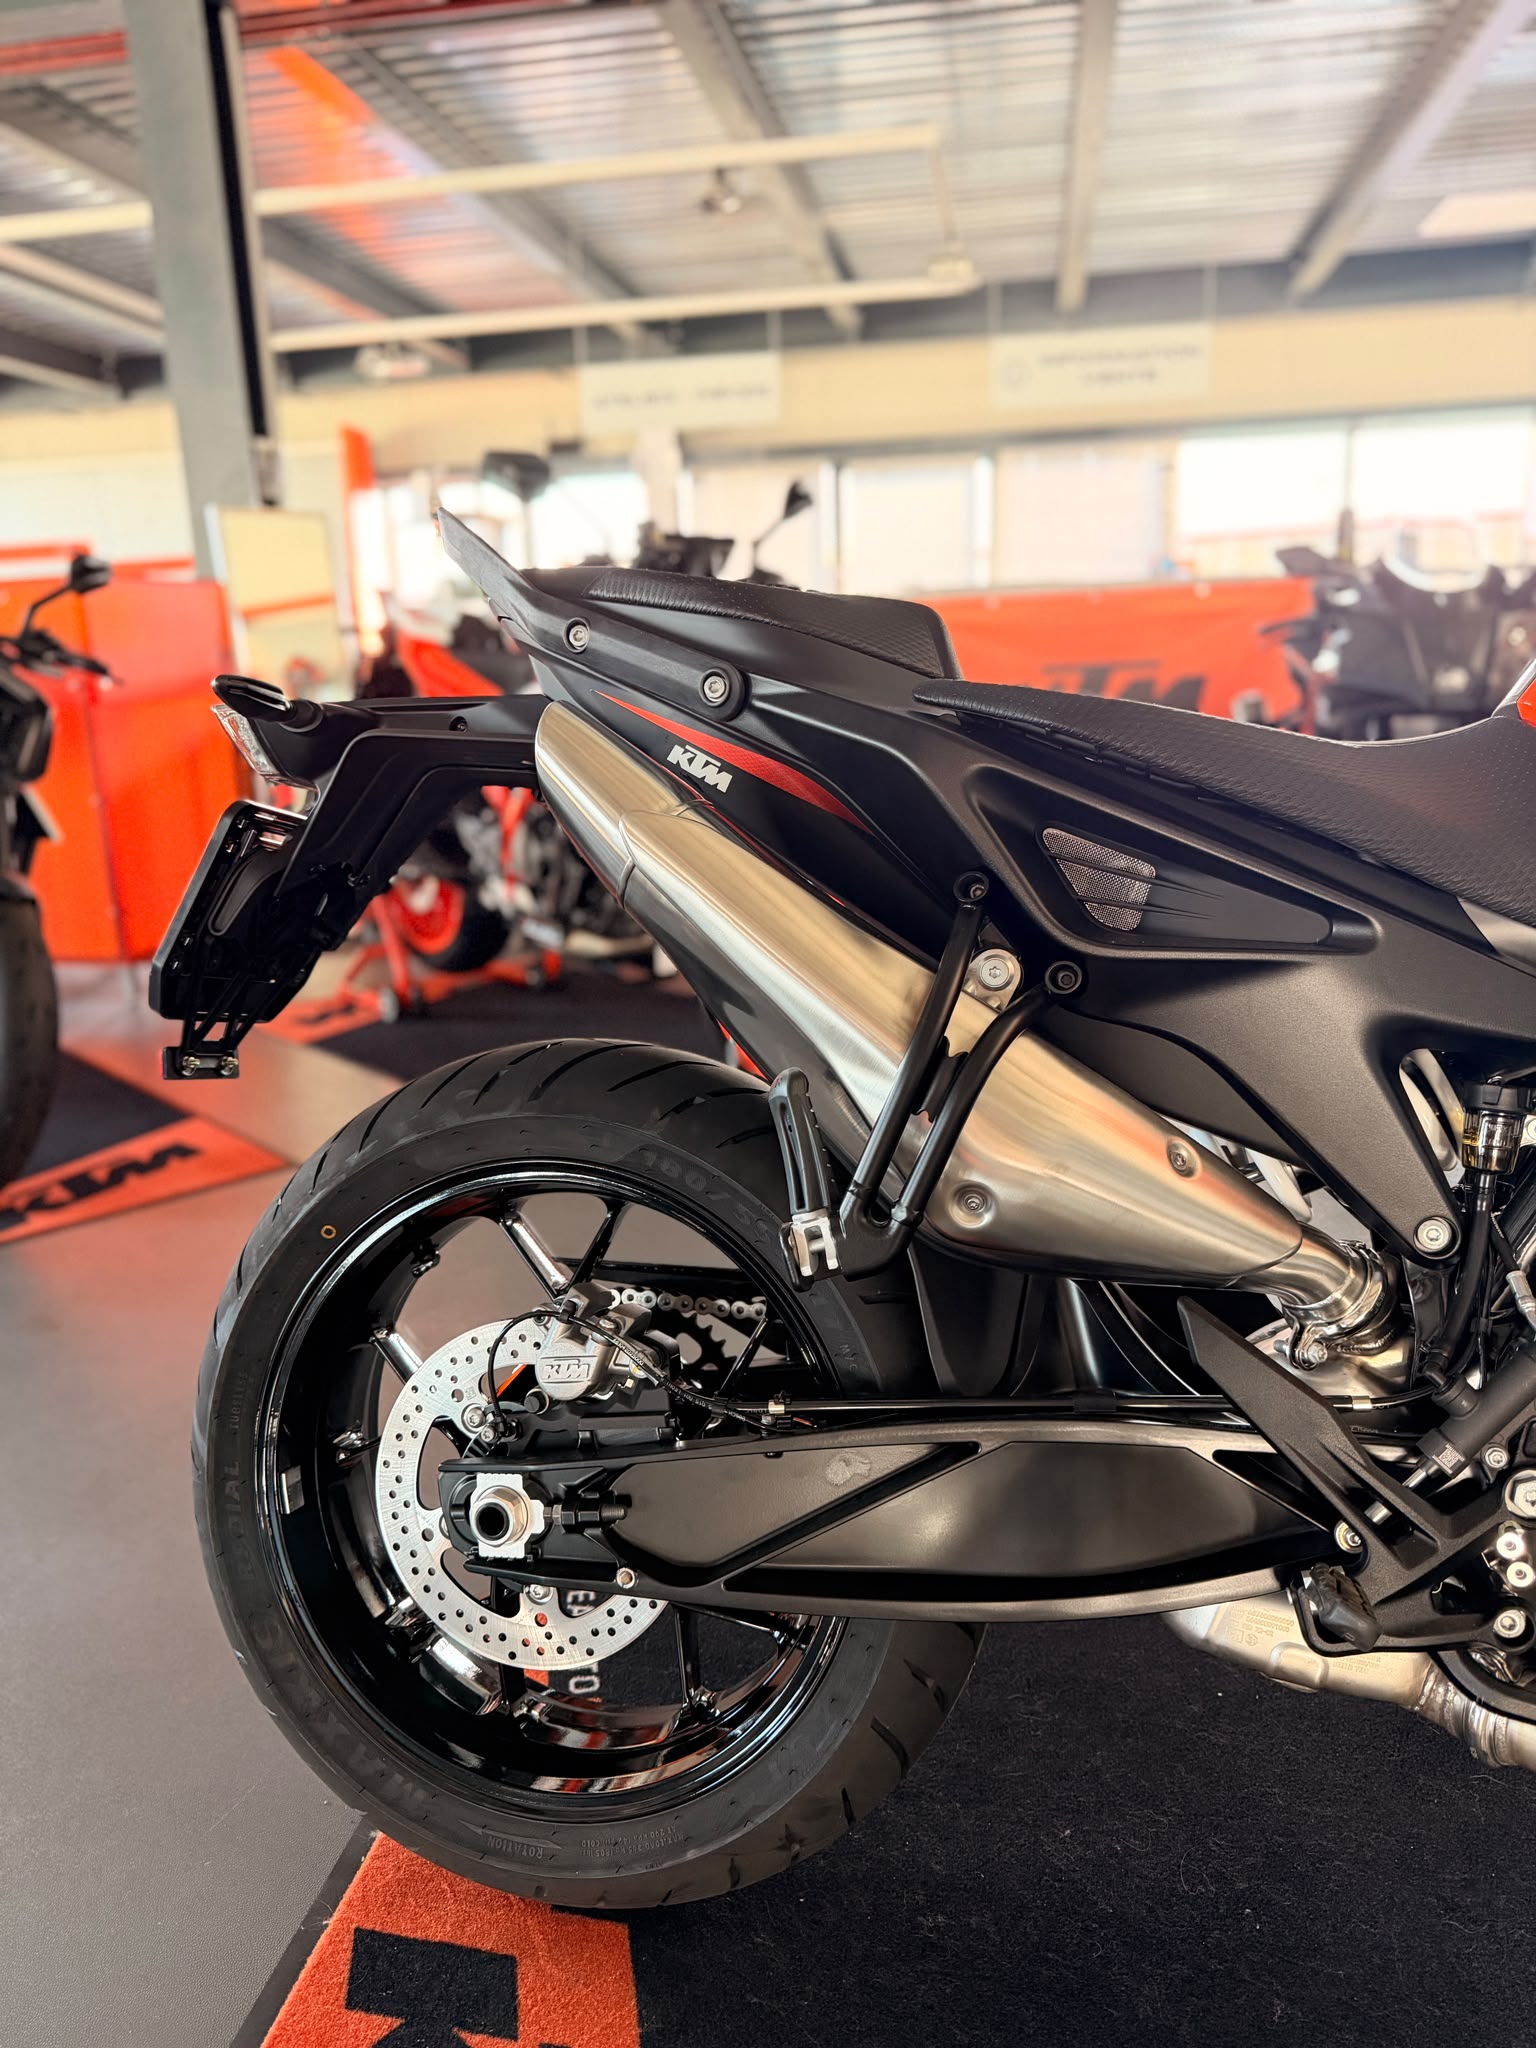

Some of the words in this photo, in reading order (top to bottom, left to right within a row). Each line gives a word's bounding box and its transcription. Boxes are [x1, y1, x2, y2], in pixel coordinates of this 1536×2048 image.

[667, 744, 733, 793] KTM
[541, 1358, 590, 1379] KTM
[487, 1835, 543, 1859] ROTATION
